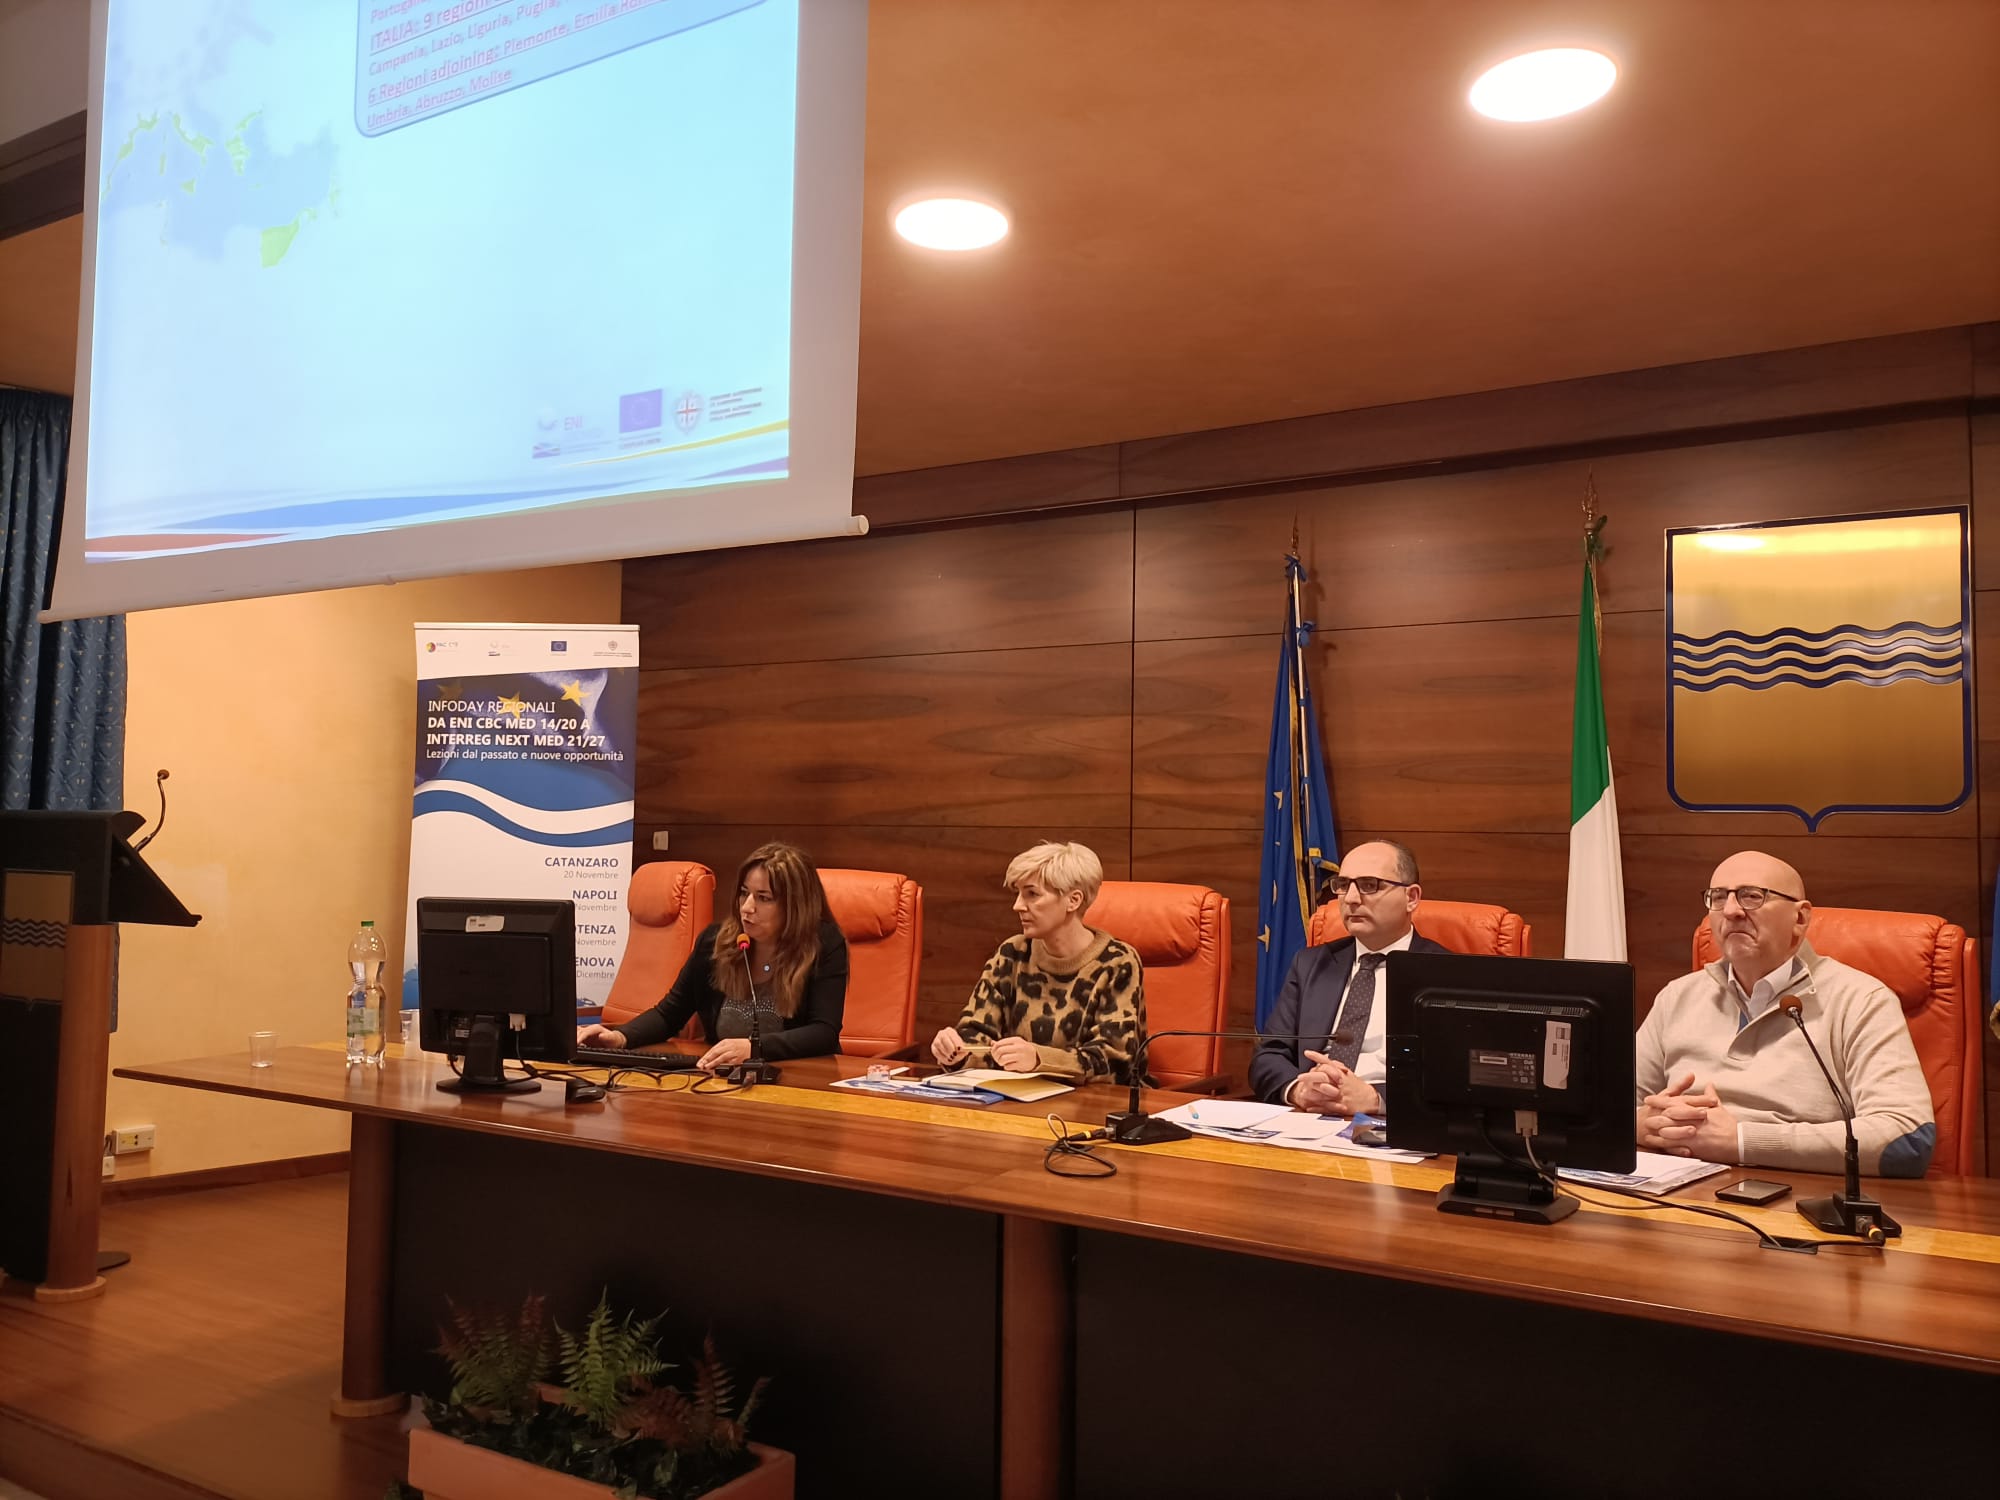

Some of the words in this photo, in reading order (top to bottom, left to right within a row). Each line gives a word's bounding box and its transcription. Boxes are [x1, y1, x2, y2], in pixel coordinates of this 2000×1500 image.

[371, 20, 419, 50] ITALIA:
[424, 12, 432, 29] 9
[369, 46, 428, 75] Campania,
[431, 32, 464, 51] Lazio,
[468, 13, 512, 39] Liguria,
[368, 88, 376, 104] 6
[380, 70, 427, 101] Regioni
[430, 46, 499, 83] adjoining:
[503, 23, 569, 55] Piemonte,
[574, 3, 617, 29] Emilia
[470, 69, 512, 93] Molise
[428, 701, 484, 712] INFODAY
[488, 701, 556, 713] REGIONALI
[428, 718, 446, 729] DA
[450, 718, 472, 729] ENI
[476, 718, 502, 729] CBC
[506, 718, 536, 729] MED
[540, 718, 577, 730] 14/20
[580, 718, 591, 730] A
[427, 734, 491, 745] INTERREG
[495, 734, 530, 746] NEXT
[534, 735, 563, 746] MED
[567, 735, 605, 747] 21/27
[427, 749, 459, 759] Lezioni
[462, 749, 477, 759] dal
[481, 751, 518, 761] passato
[521, 752, 528, 760] e
[530, 752, 561, 760] nuove
[564, 751, 624, 762] opportunità
[545, 857, 619, 868] CATANZARO
[564, 870, 573, 879] 20
[576, 871, 618, 879] Novembre
[573, 890, 617, 900] NAPOLI
[575, 925, 616, 935] TENZA
[575, 957, 615, 967] ENOVA
[576, 970, 615, 979] Dicembre
